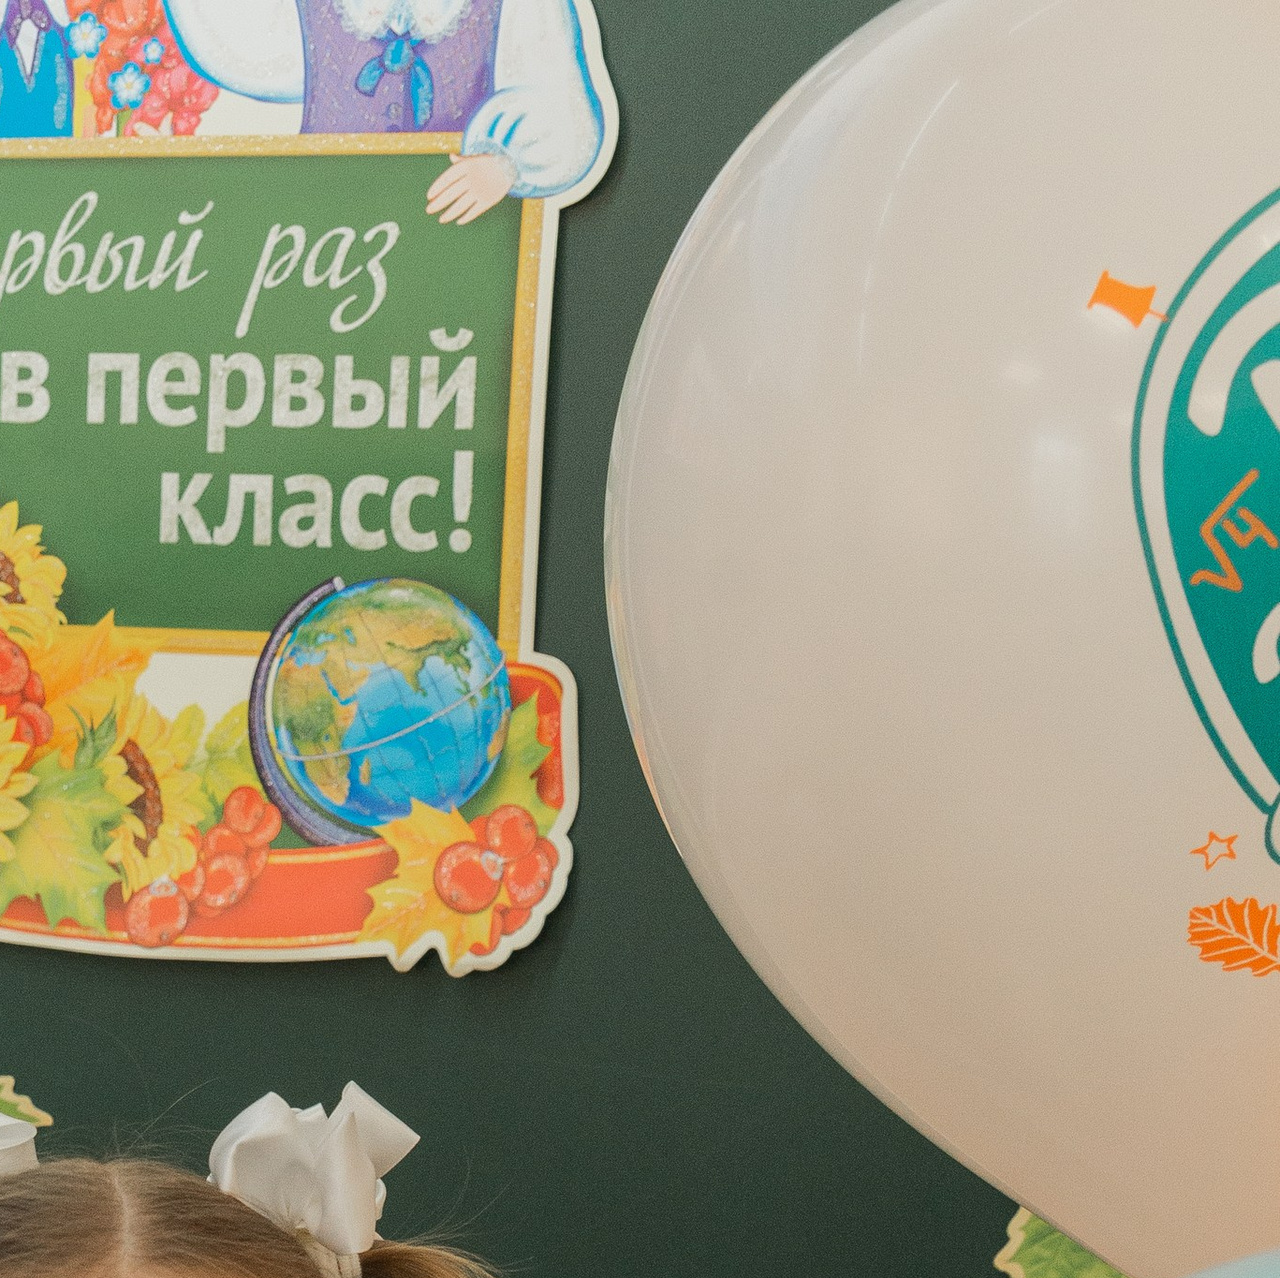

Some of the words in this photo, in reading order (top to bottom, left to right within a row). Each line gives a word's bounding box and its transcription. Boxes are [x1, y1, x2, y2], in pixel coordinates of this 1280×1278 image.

[235, 220, 401, 338] раз
[0, 350, 50, 425] в
[86, 327, 477, 454] первый
[158, 450, 475, 553] класс!
